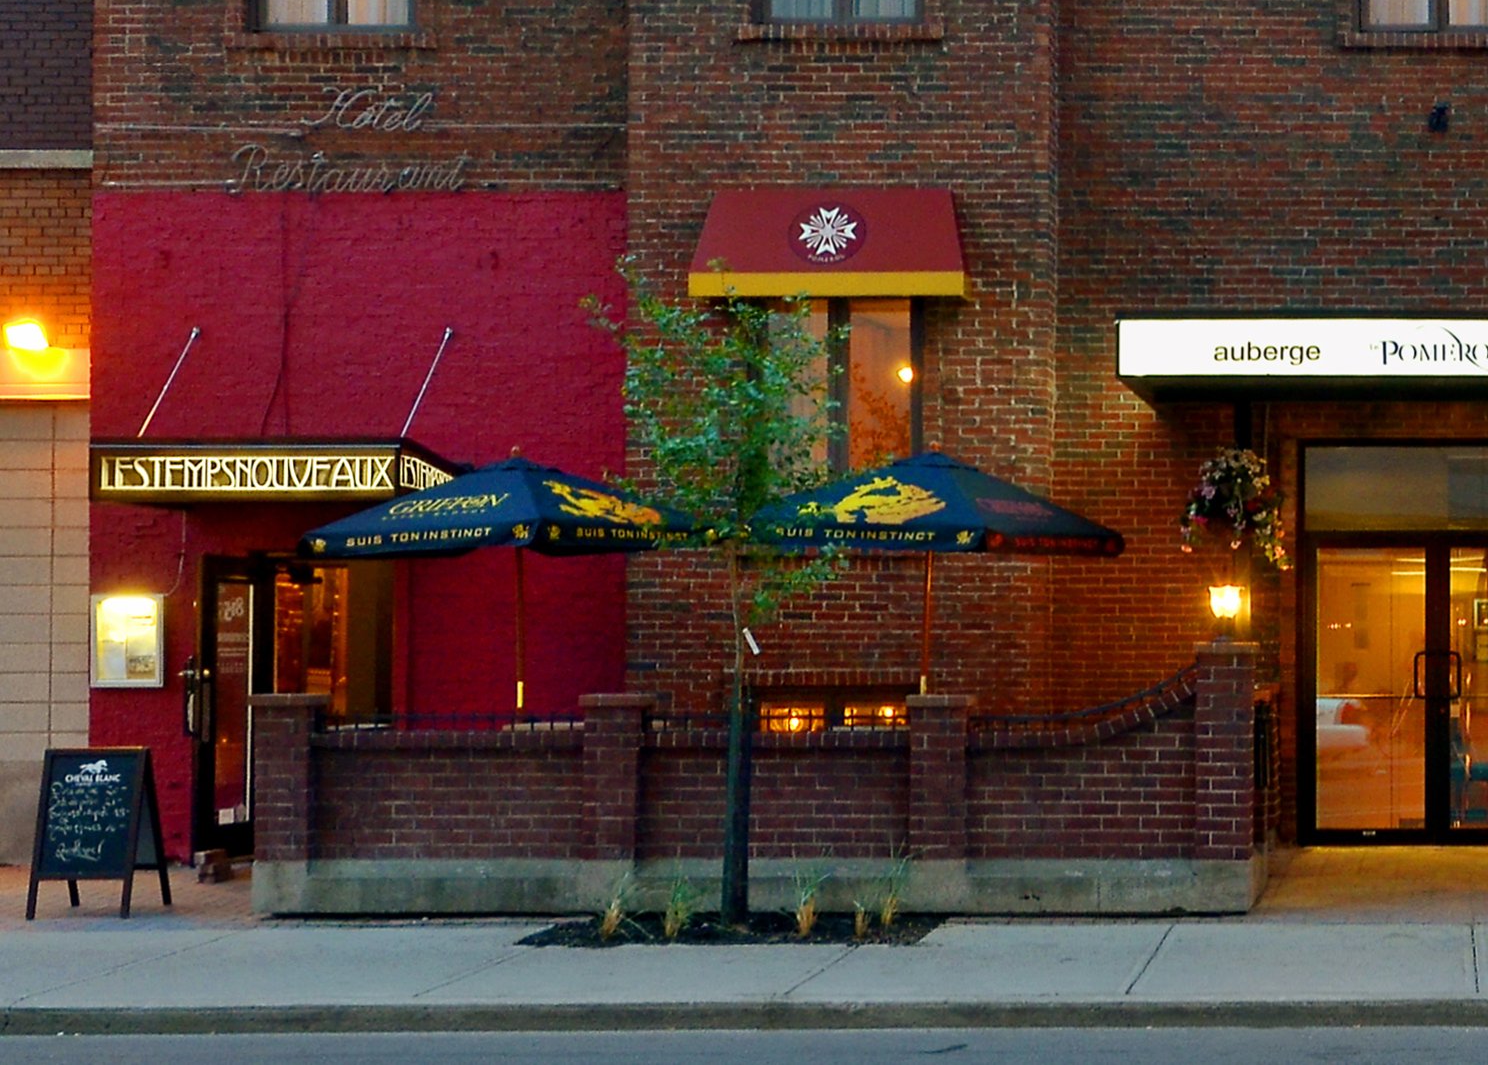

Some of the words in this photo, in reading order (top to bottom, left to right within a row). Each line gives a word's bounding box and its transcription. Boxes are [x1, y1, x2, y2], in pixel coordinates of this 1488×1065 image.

[231, 144, 468, 193] Restaurant
[1213, 341, 1322, 366] auberge
[346, 534, 383, 547] SUIS
[390, 532, 420, 543] TON
[423, 526, 493, 540] INSTINCT
[824, 528, 857, 539] TON
[860, 530, 936, 541] INSTINCT
